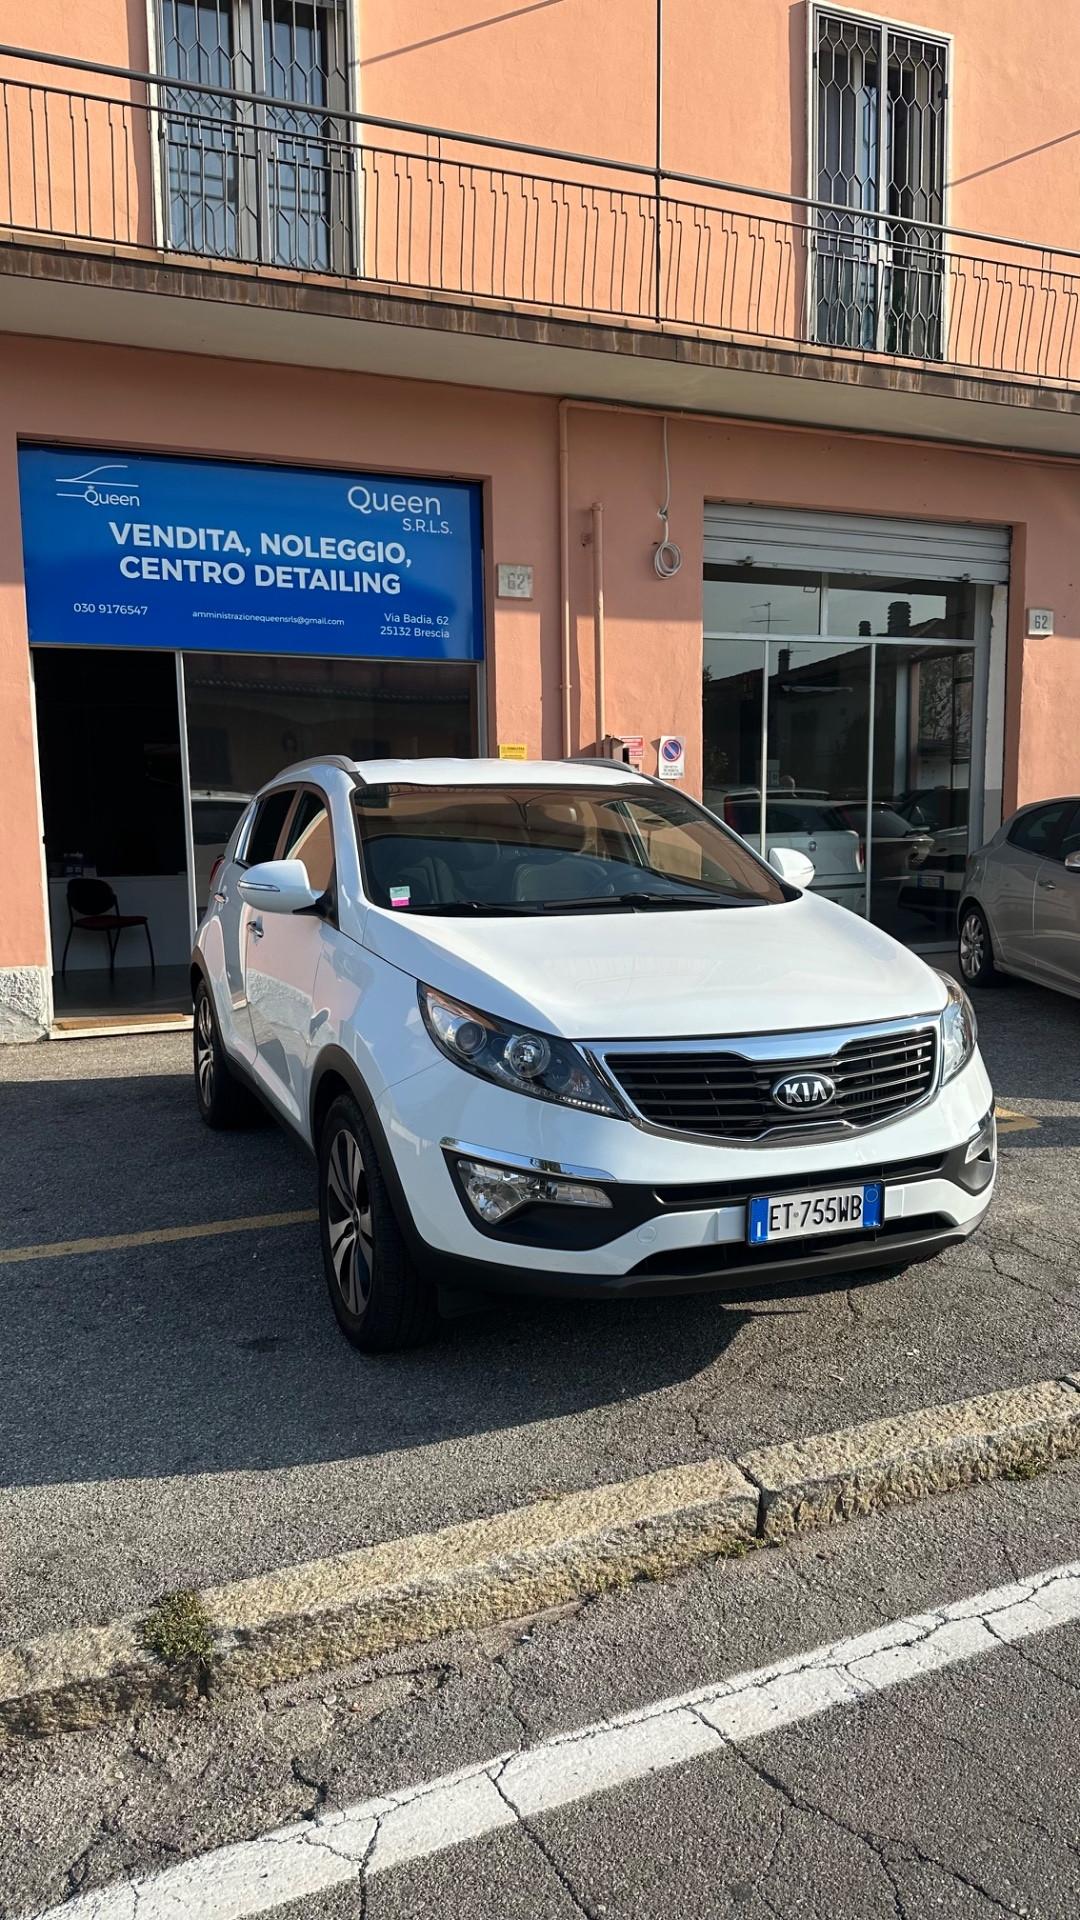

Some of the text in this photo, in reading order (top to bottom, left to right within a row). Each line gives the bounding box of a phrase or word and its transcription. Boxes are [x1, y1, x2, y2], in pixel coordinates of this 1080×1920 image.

[84, 488, 140, 506] Queen
[347, 485, 441, 516] Queen
[402, 518, 453, 534] S.R.L.S.
[108, 521, 412, 568] VENDITA, NOLEGGIO,
[119, 555, 401, 595] CENTRO DETAILING
[73, 603, 148, 615] 030 9176547
[383, 612, 449, 626] Via Badia, 62
[1034, 614, 1048, 629] 62
[380, 626, 450, 638] 25132 Brescia
[783, 1080, 828, 1104] KIA
